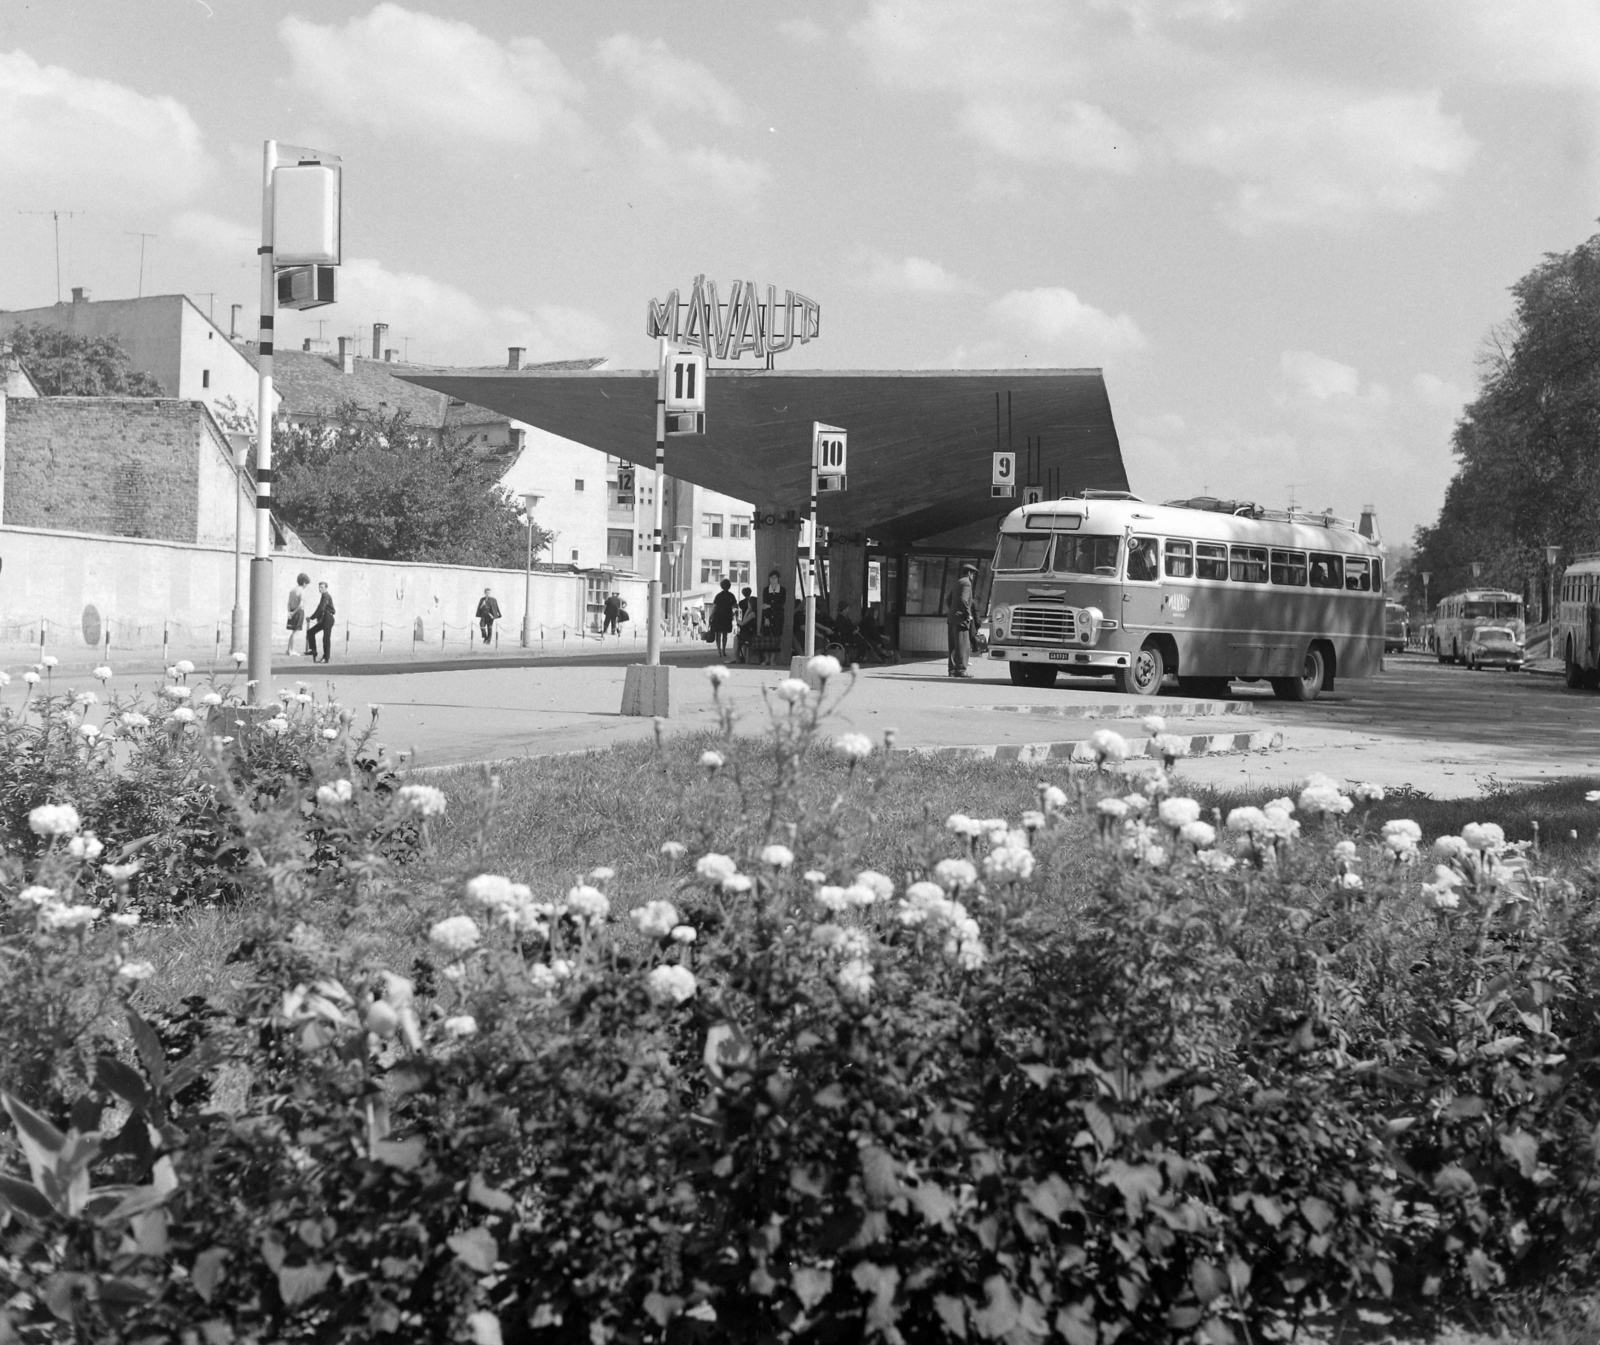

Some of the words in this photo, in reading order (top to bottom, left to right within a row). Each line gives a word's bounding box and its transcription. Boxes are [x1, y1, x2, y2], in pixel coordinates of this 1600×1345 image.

[647, 274, 818, 360] MÁVAUT
[674, 363, 696, 399] 11
[822, 440, 843, 467] 10
[999, 456, 1011, 478] 9
[618, 474, 631, 490] 12
